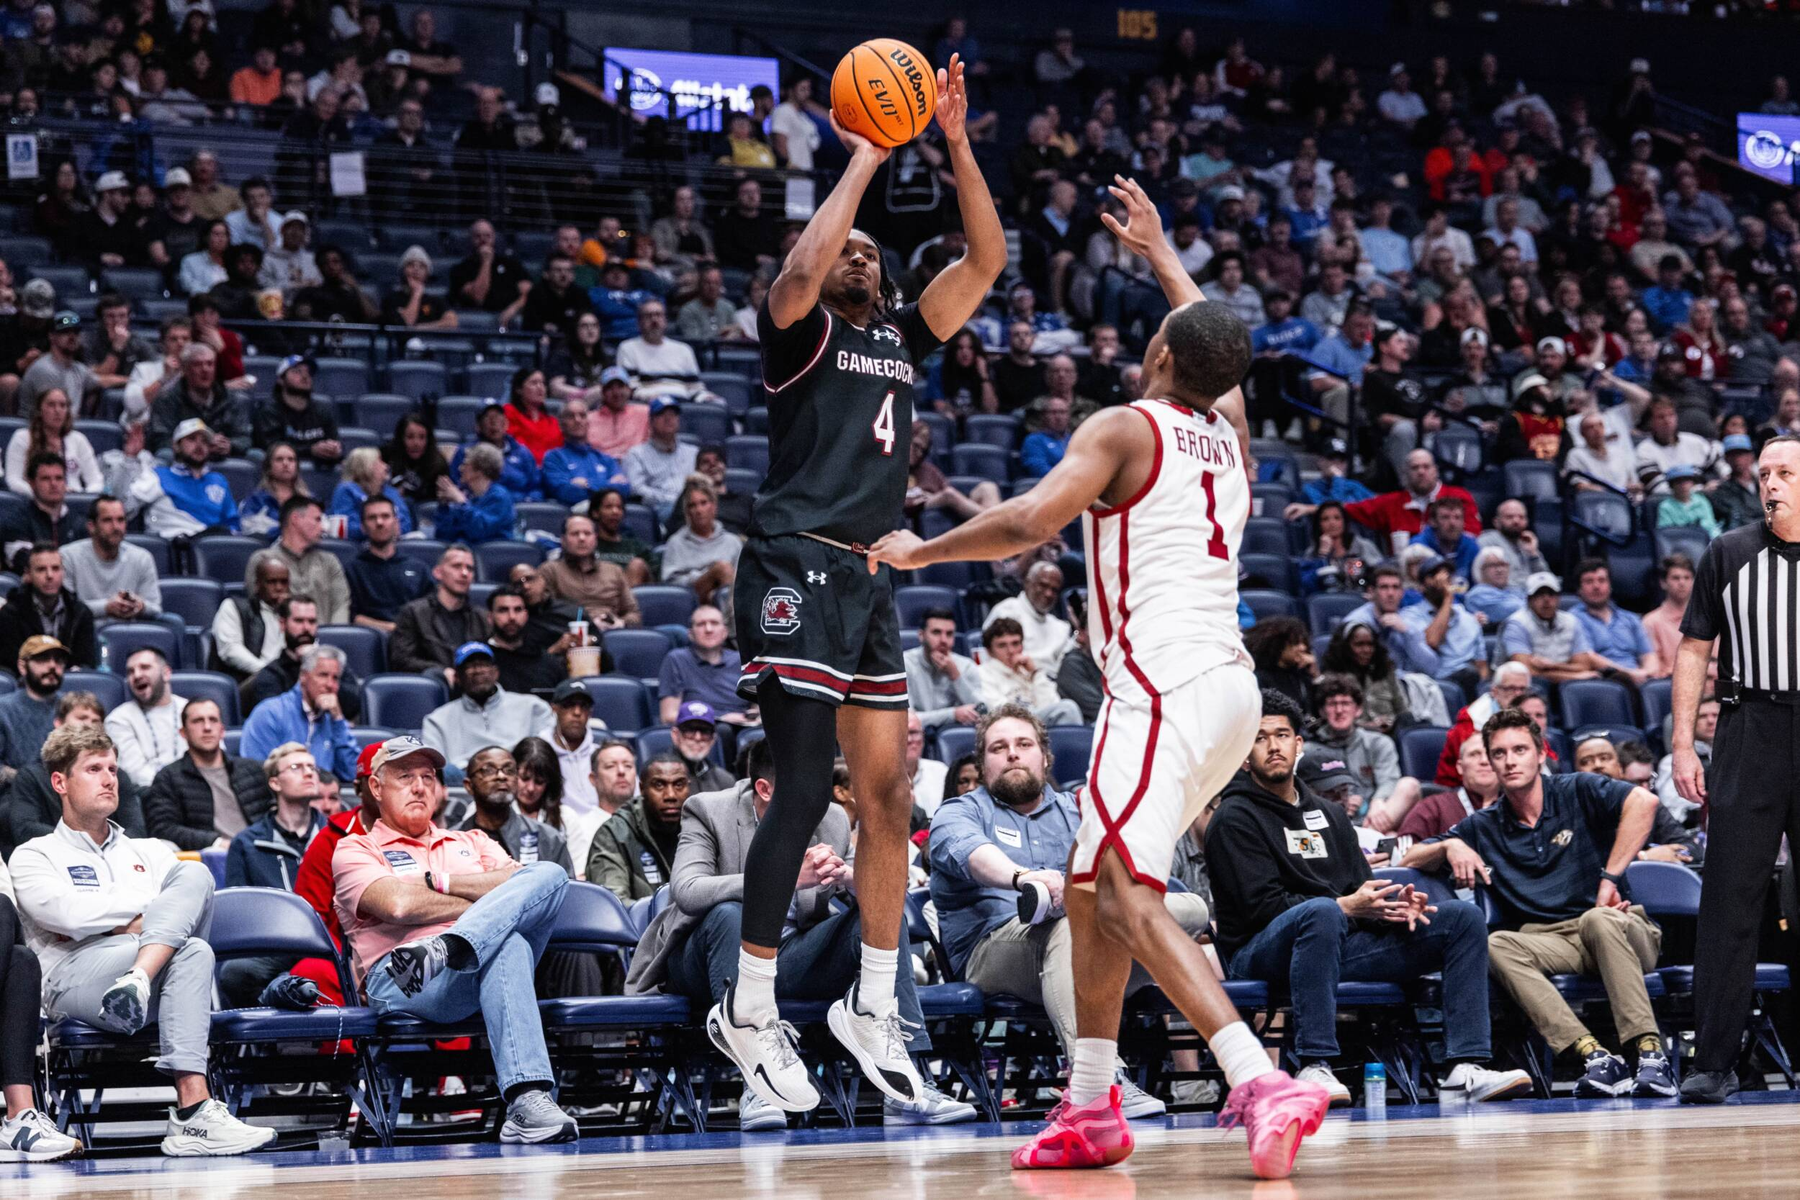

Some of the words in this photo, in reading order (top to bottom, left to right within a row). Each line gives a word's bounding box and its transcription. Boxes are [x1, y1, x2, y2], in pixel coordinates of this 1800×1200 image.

[1117, 9, 1156, 39] 105
[890, 48, 927, 117] Wilson
[872, 389, 896, 456] 4
[1173, 426, 1236, 469] BROWN
[1201, 470, 1229, 562] 1
[182, 1126, 208, 1139] HOKA
